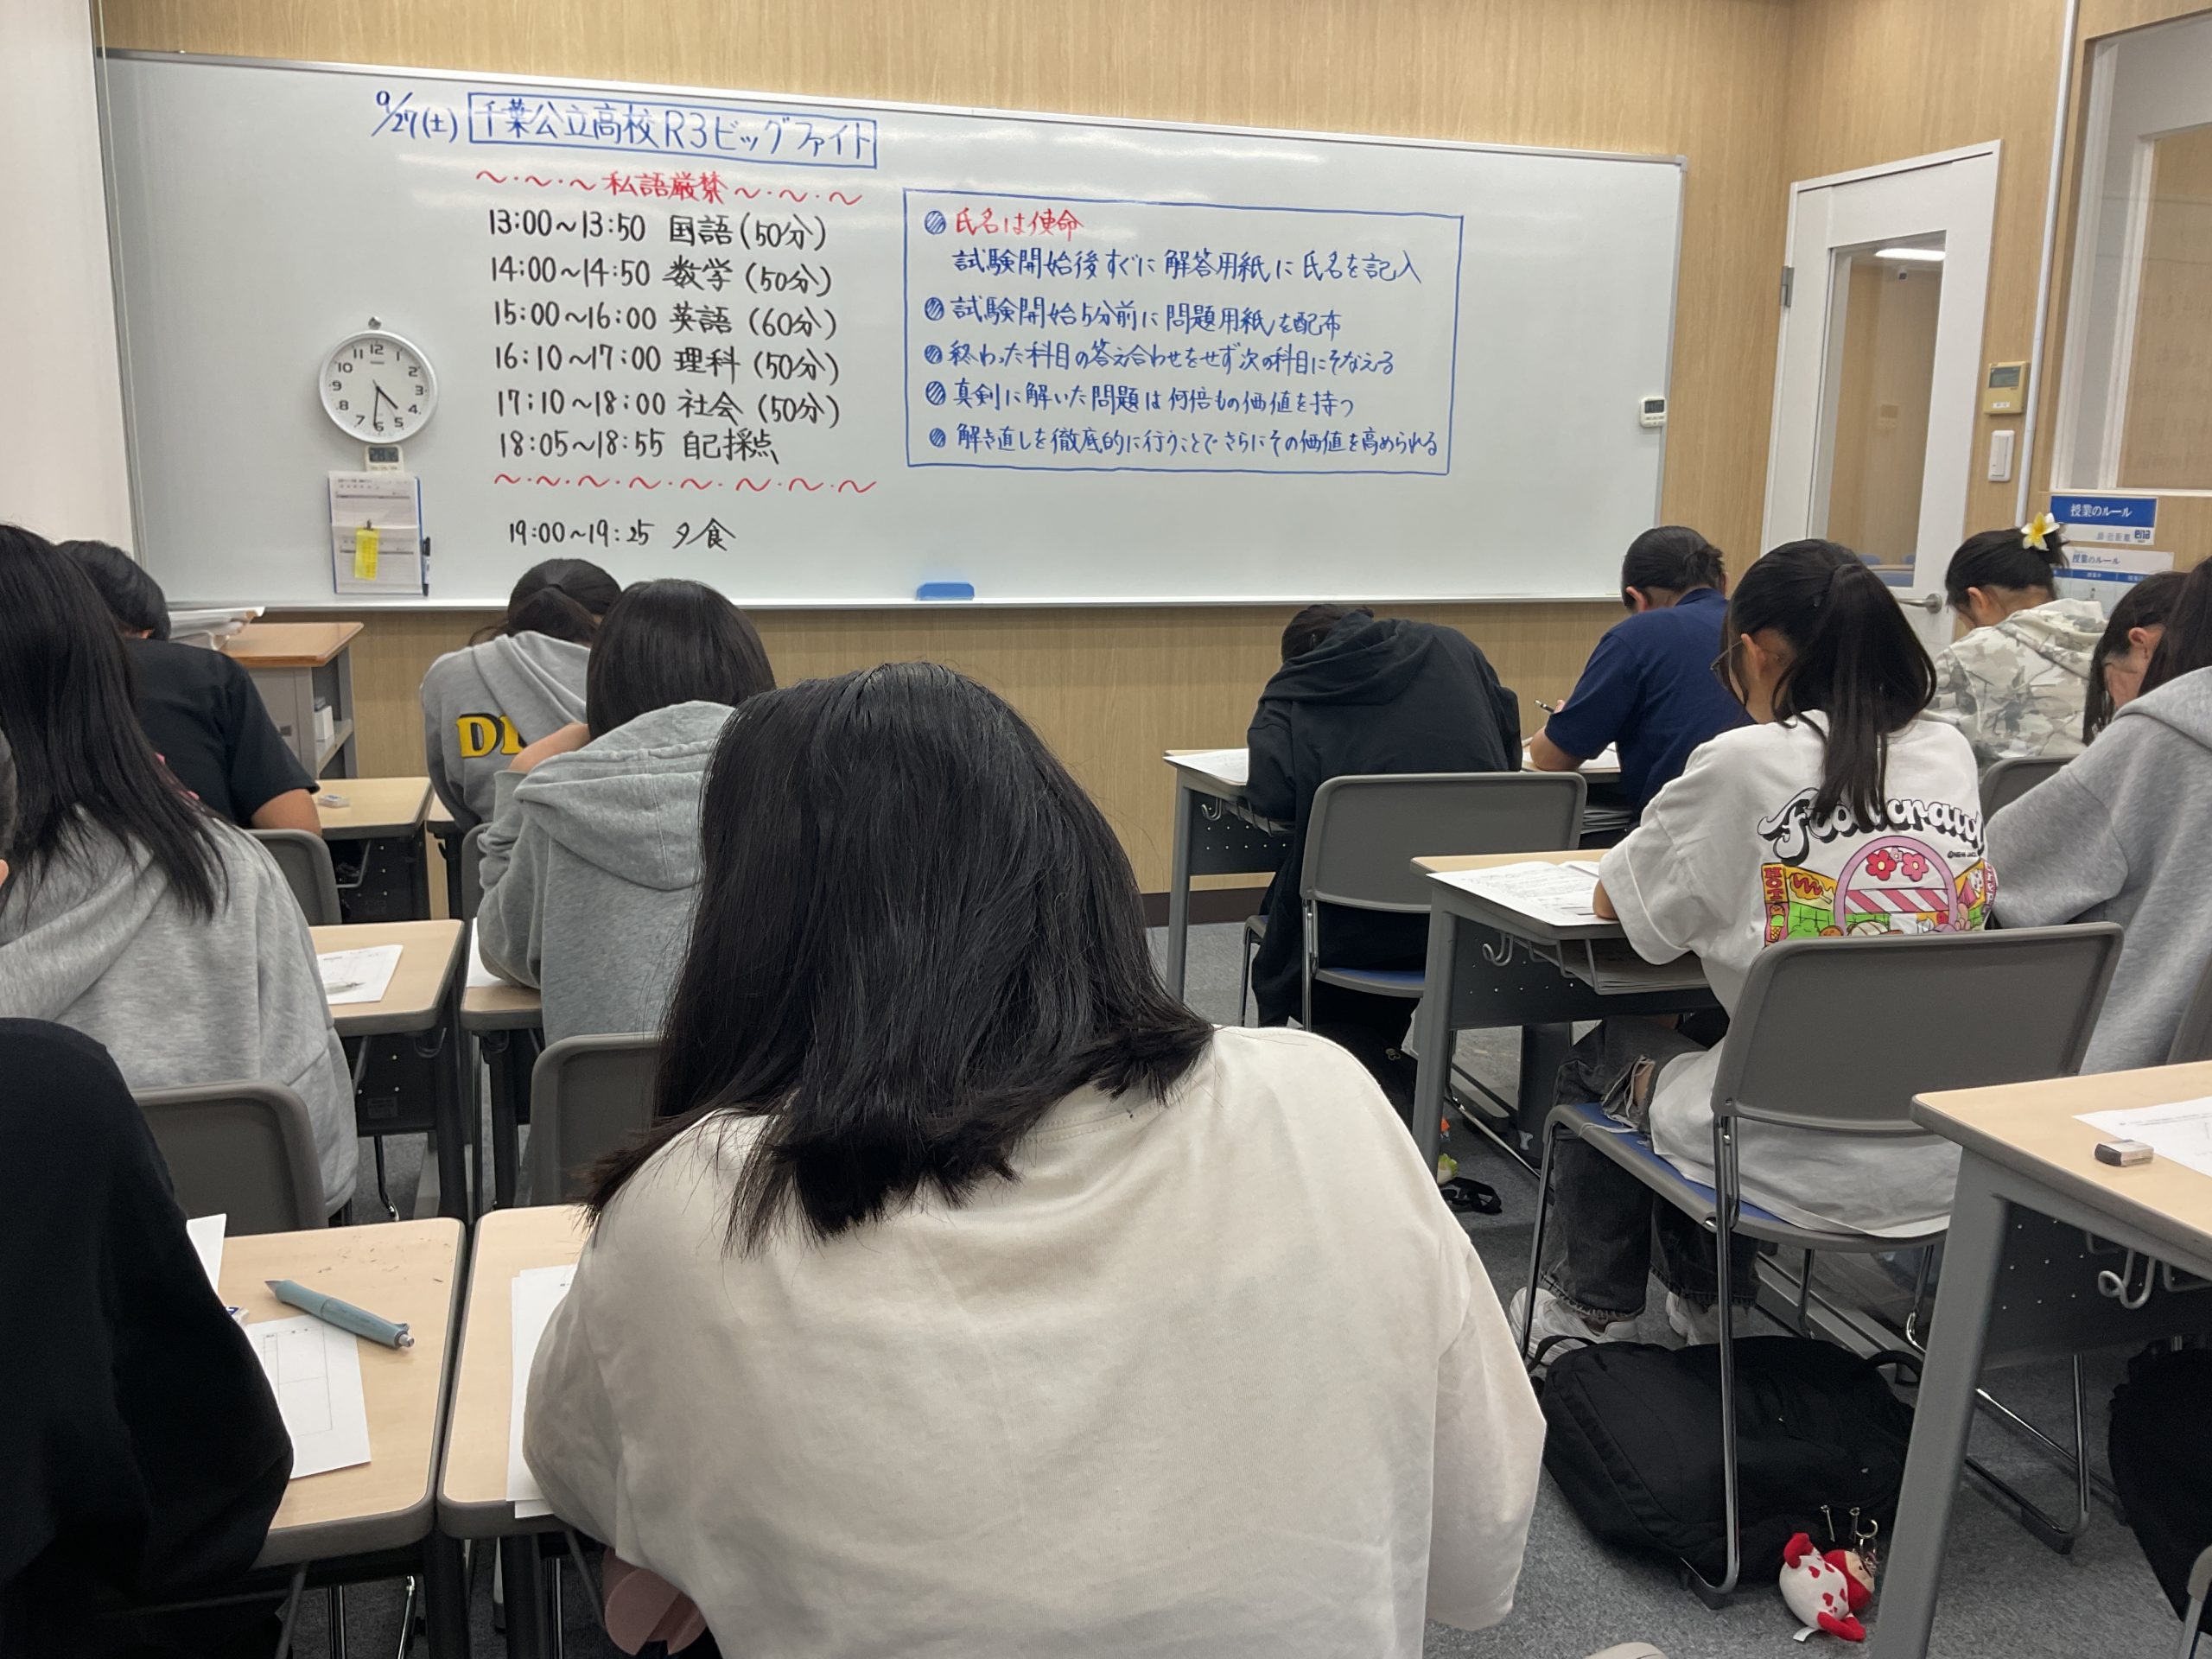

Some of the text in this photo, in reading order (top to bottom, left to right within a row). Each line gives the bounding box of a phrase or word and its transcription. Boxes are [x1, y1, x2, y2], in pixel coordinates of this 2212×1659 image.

[603, 170, 728, 205] 私語厳禁
[956, 207, 1084, 242] 氏名は使命
[353, 348, 364, 359] 11
[370, 344, 384, 355] 12
[338, 363, 353, 373] 10
[683, 427, 780, 465] 自己採点
[2070, 504, 2133, 518] 授業のルール
[671, 518, 737, 551] 夕食
[2072, 553, 2120, 565] 授業のルール
[1764, 867, 1783, 900] HOT
